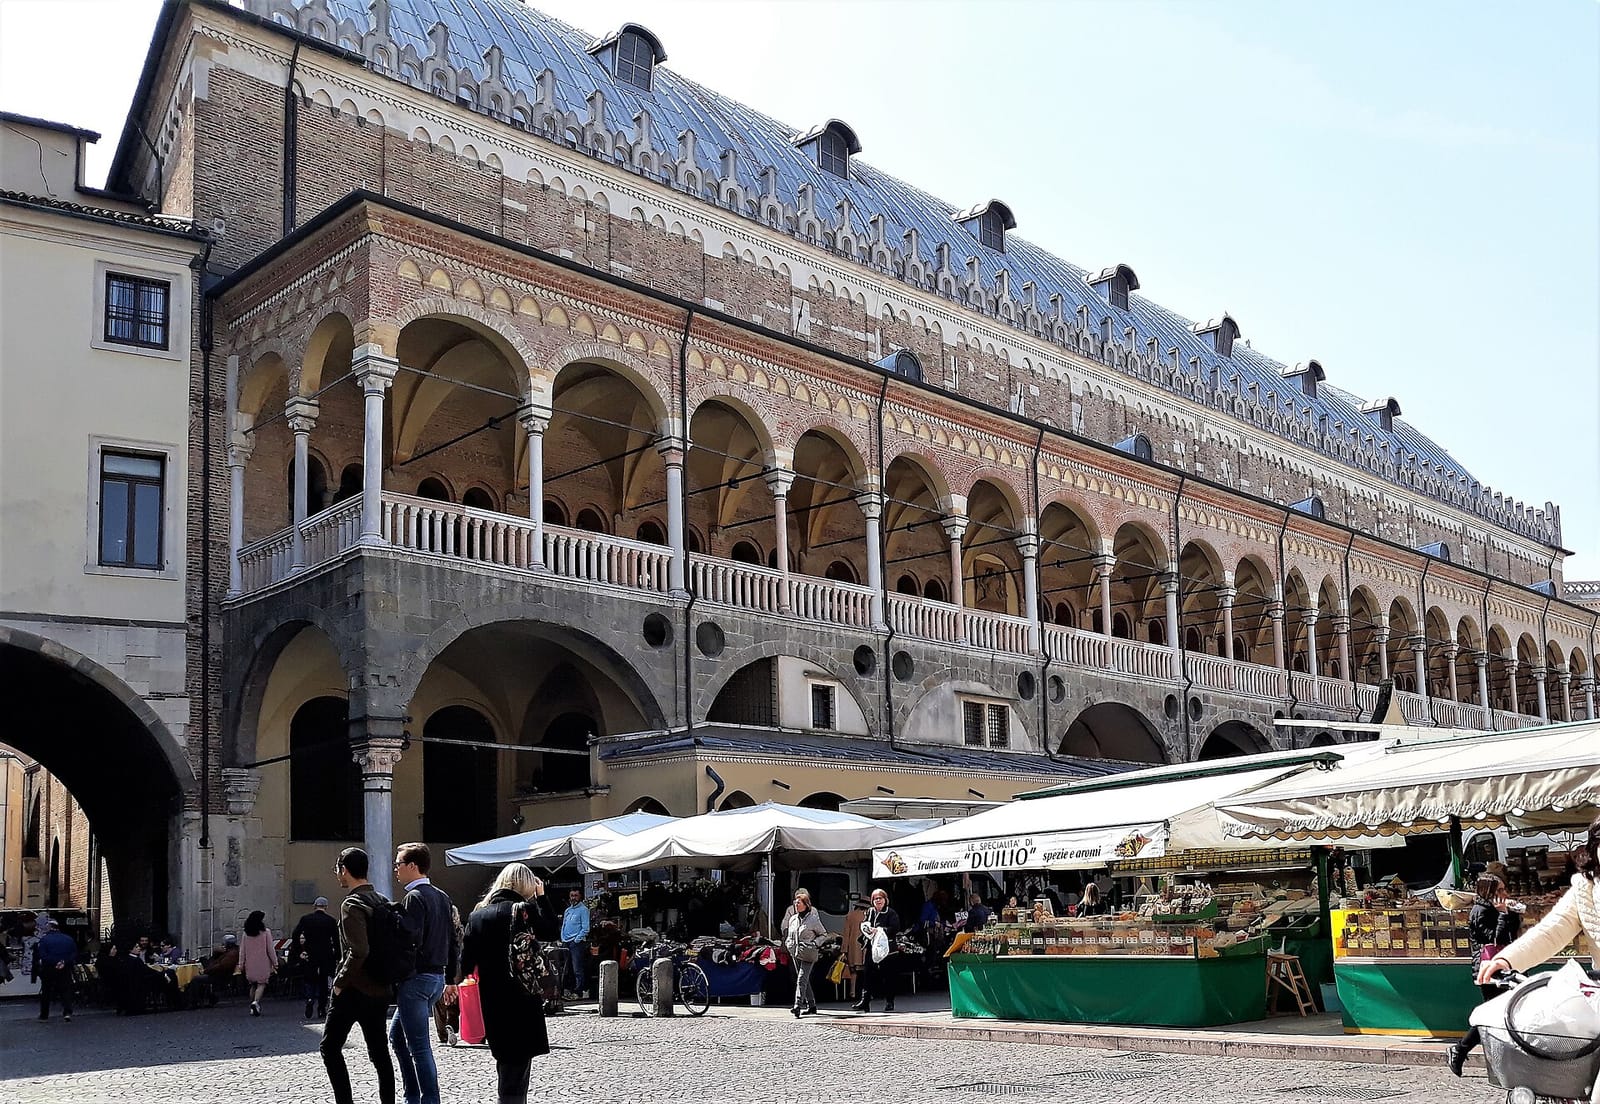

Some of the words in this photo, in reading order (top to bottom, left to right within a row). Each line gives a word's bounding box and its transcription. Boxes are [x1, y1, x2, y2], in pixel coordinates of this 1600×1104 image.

[967, 843, 975, 851] LE
[1025, 838, 1033, 846] DI
[1042, 848, 1068, 862] spezie
[1069, 850, 1075, 859] e
[1075, 845, 1102, 858] aromi
[939, 859, 959, 869] secca
